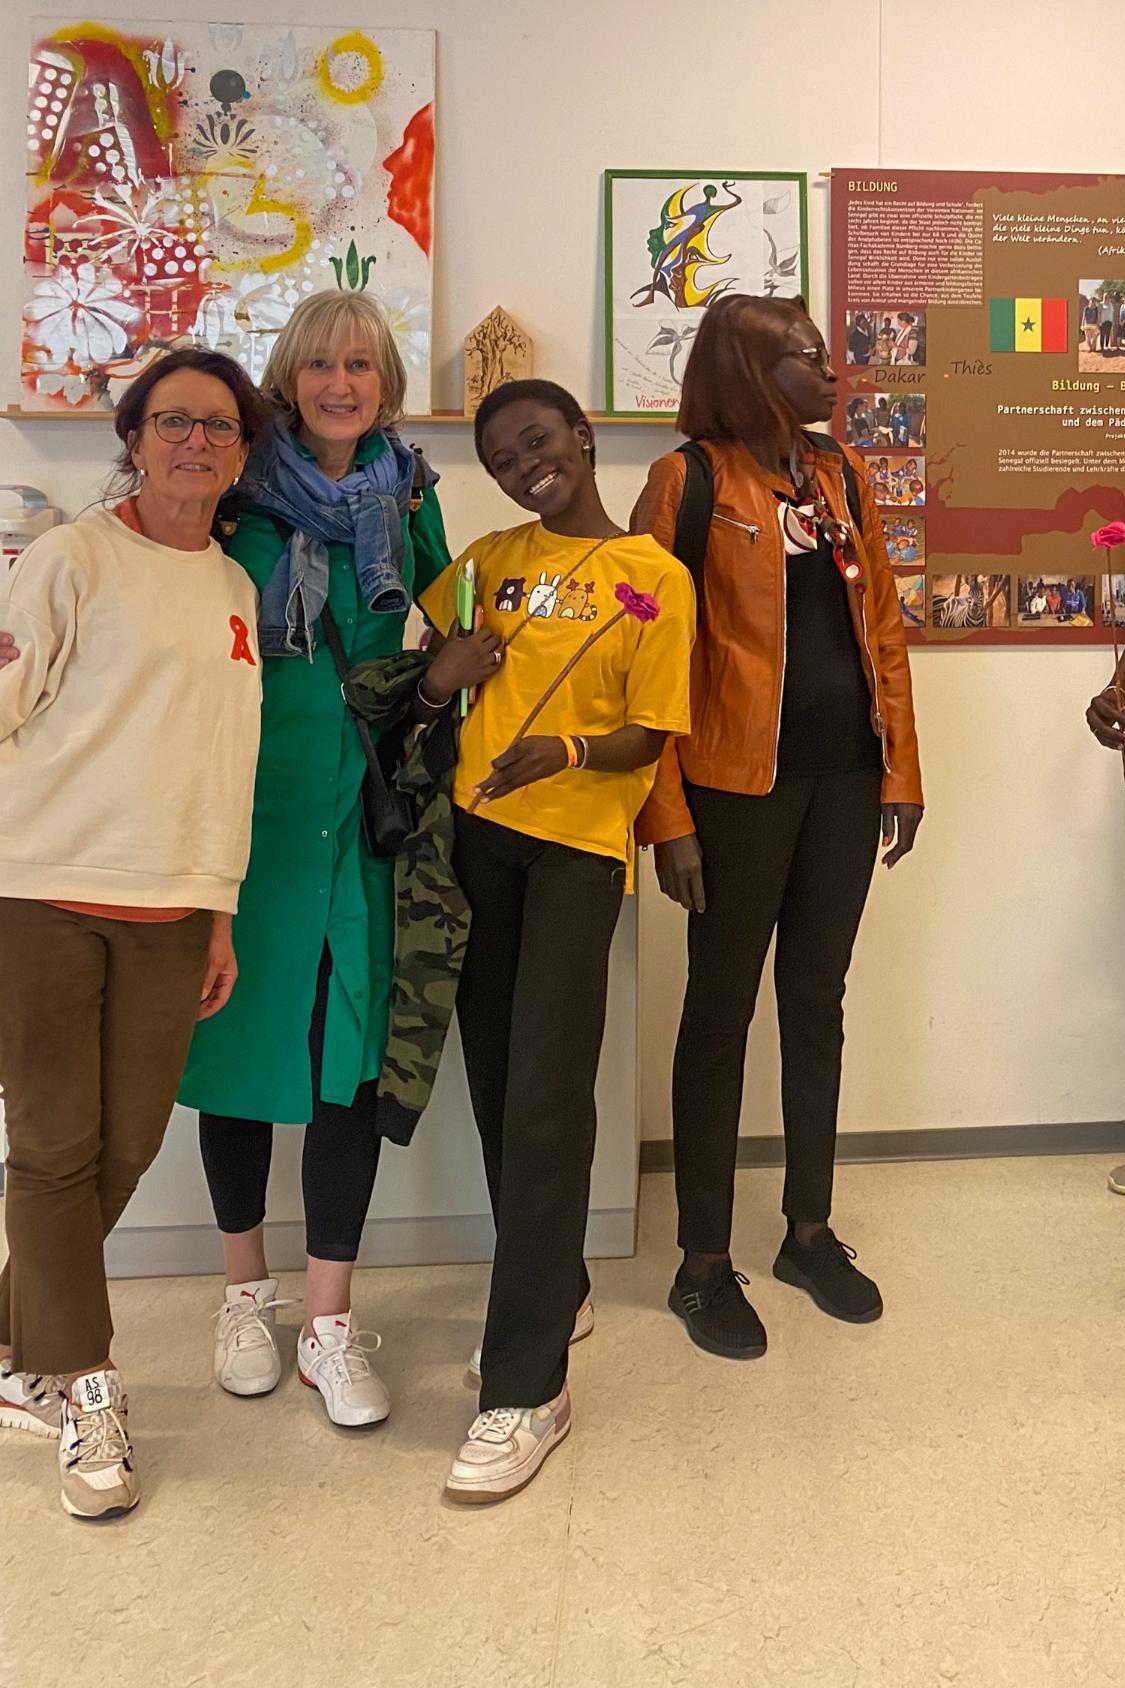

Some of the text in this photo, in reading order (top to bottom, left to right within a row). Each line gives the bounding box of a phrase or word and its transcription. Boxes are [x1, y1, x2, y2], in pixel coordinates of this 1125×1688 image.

[848, 181, 898, 192] BILDUNG
[992, 214, 1014, 222] Viele
[1017, 214, 1045, 223] kleine
[1047, 215, 1094, 224] Menschen,
[992, 224, 1006, 232] die
[1034, 225, 1062, 233] kleine
[1064, 225, 1090, 235] Dinge
[1092, 226, 1113, 235] tun,
[1033, 235, 1083, 244] verändern.
[951, 360, 992, 376] Thiès
[875, 370, 926, 384] Dakar
[1052, 380, 1100, 393] Bildung
[997, 405, 1074, 415] Partnerschaft
[1062, 418, 1080, 427] und
[1085, 418, 1103, 427] dem
[998, 457, 1023, 466] Senegal
[1050, 457, 1081, 466] besiegelt.
[87, 1388, 103, 1405] 98
